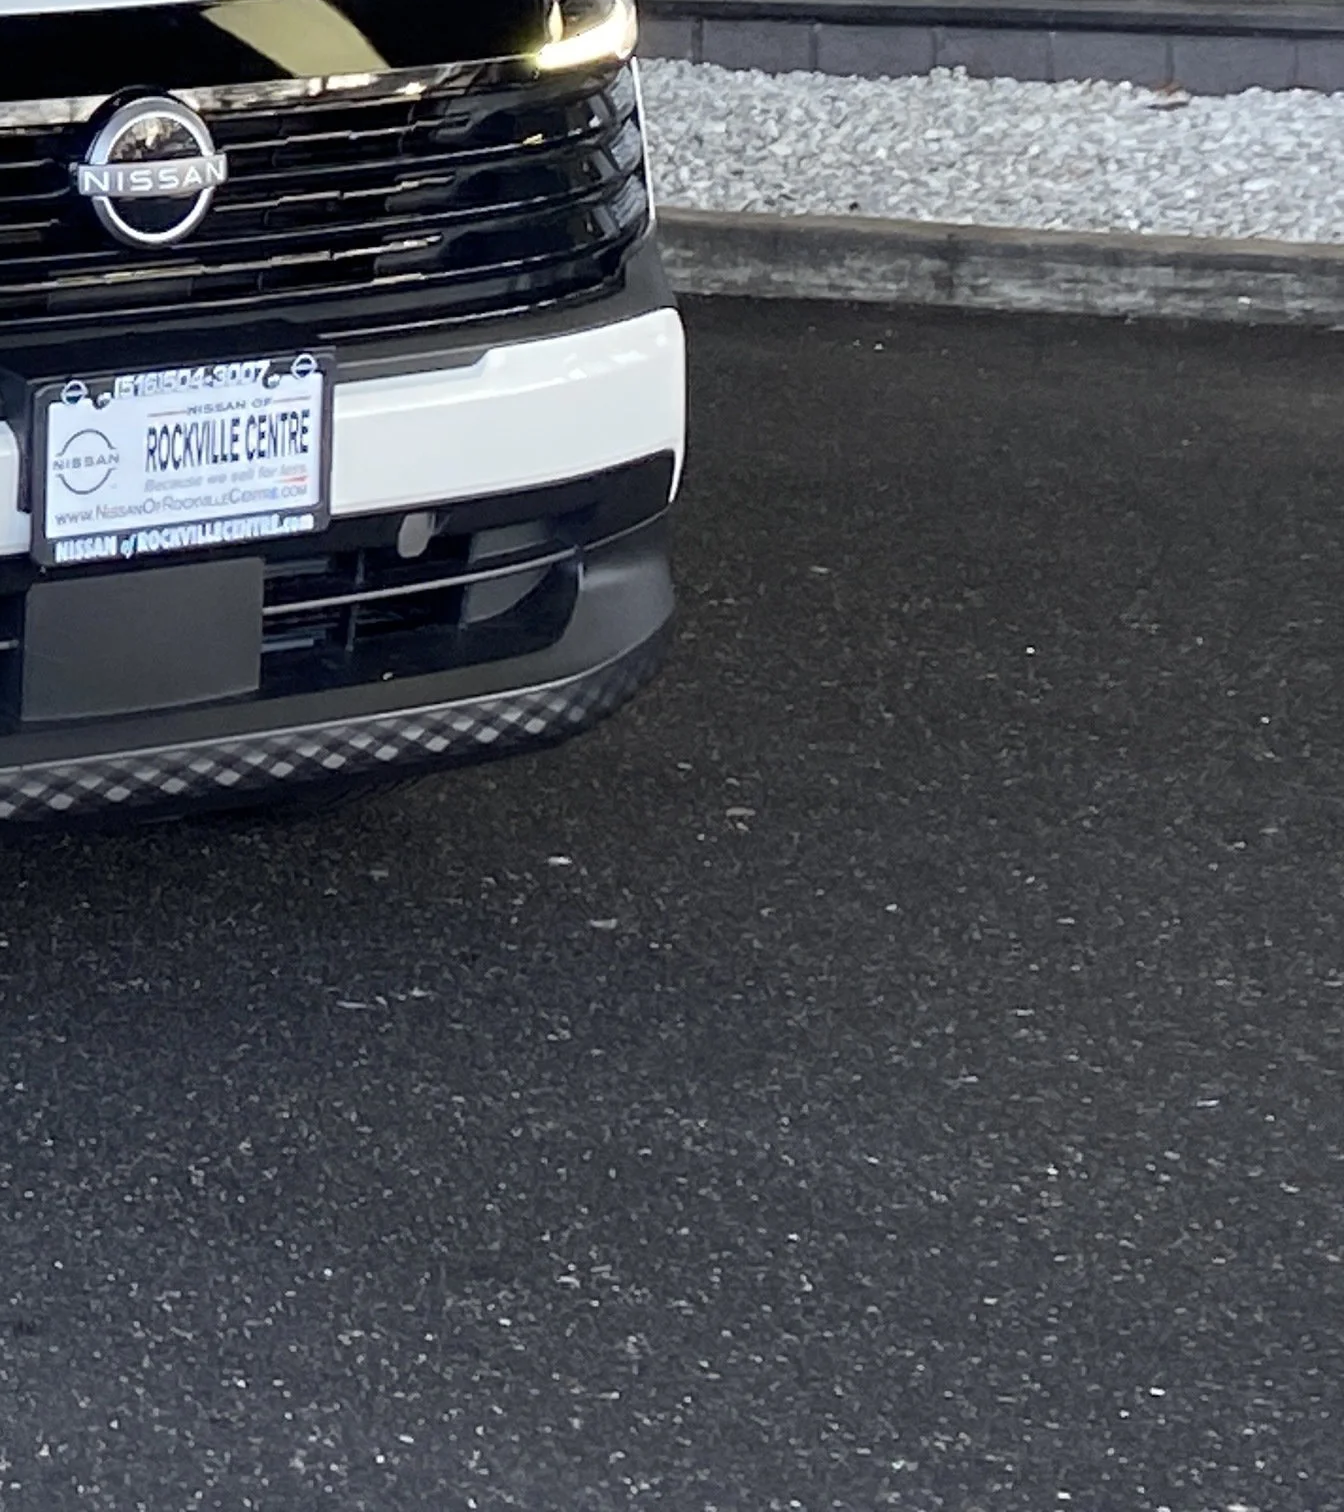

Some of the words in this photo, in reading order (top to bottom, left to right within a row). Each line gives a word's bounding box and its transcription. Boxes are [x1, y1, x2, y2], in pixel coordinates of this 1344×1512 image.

[83, 159, 224, 192] NISSAN
[186, 401, 247, 417] NISSAN
[251, 396, 273, 410] OF
[145, 418, 241, 474] ROCKVILLE
[244, 408, 311, 462] CENTRE
[53, 453, 120, 471] NISSAN
[55, 534, 117, 564] NISSAN
[120, 533, 137, 560] of
